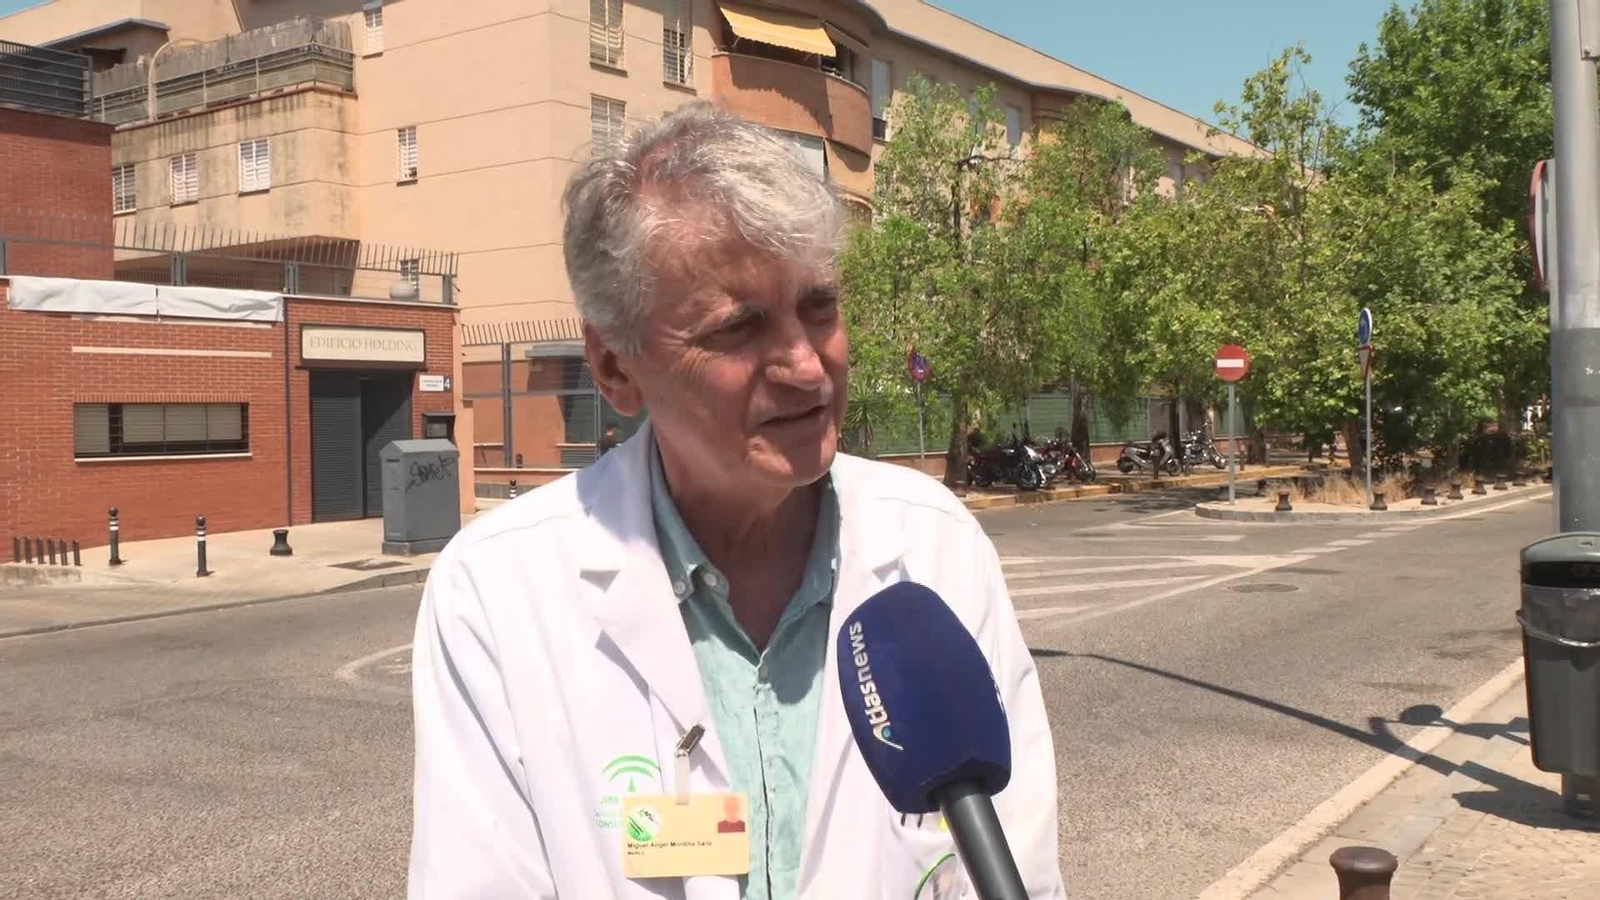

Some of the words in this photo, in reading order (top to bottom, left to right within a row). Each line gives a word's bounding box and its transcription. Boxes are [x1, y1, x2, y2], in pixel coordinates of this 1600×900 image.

[310, 336, 361, 349] EDIFICIO
[364, 339, 418, 352] HOLDING
[444, 378, 451, 389] 4
